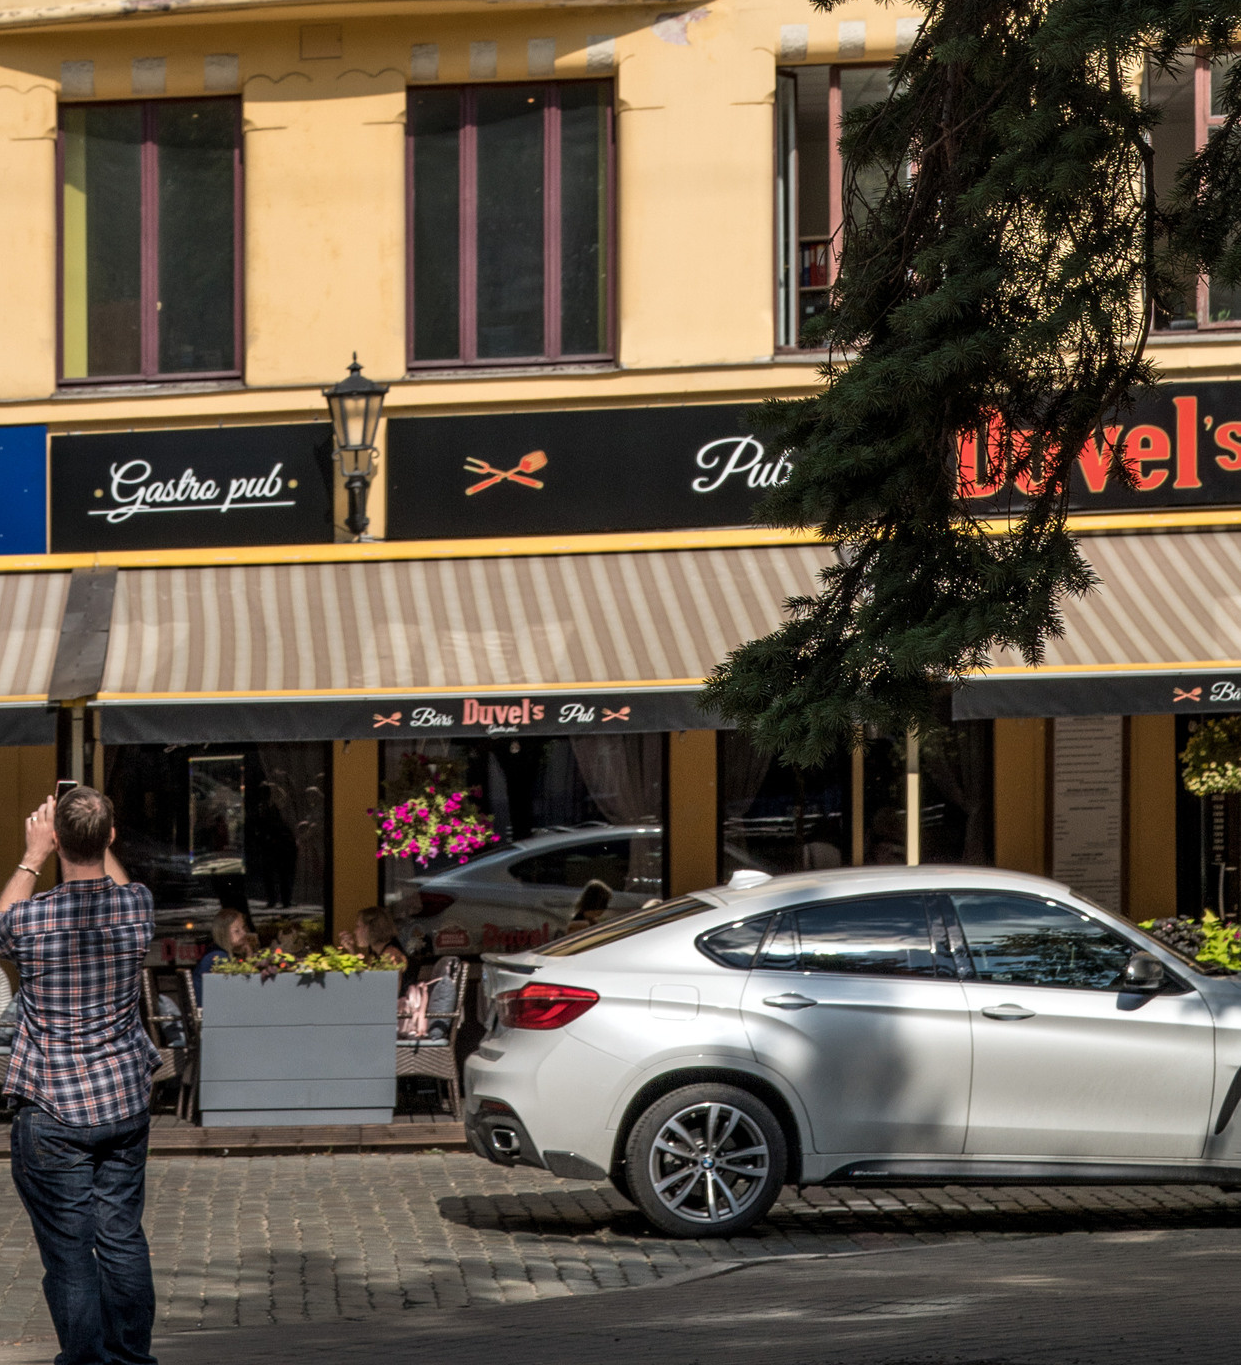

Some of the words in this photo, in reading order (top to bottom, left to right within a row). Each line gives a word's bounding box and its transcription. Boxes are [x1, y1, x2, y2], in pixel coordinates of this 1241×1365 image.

[106, 459, 220, 523] Gastro
[220, 462, 283, 513] pub
[691, 434, 795, 493] Pub
[462, 698, 545, 725] Duvel's
[558, 703, 595, 724] Pub
